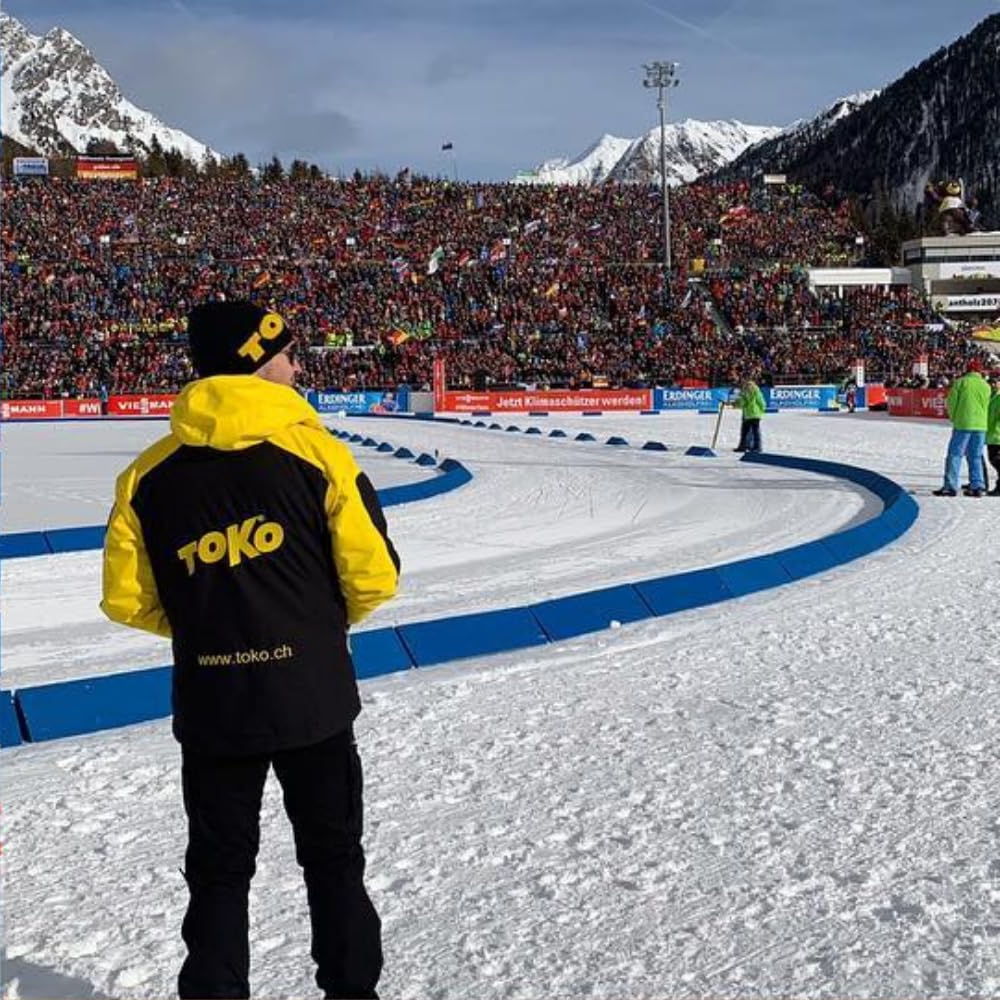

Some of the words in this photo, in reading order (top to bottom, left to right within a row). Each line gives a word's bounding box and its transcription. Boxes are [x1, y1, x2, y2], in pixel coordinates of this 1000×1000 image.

[663, 389, 712, 401] ERDINGER
[770, 388, 820, 400] ERDINGER
[497, 396, 522, 408] Jetzt
[177, 515, 285, 577] TOKO
[198, 644, 293, 666] www.toko.ch
